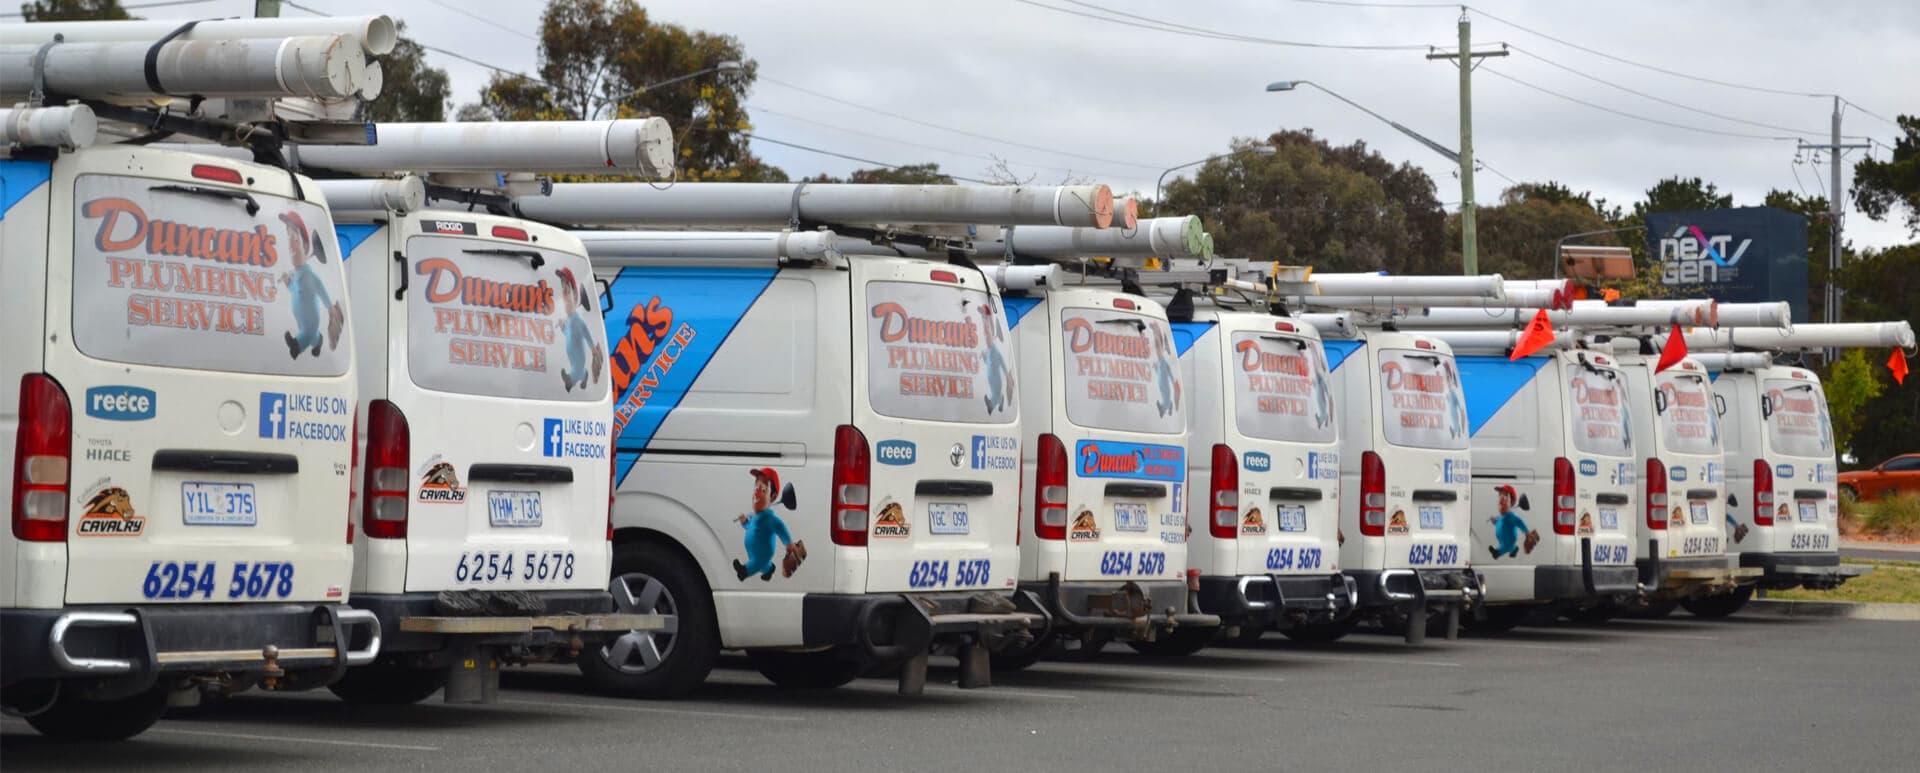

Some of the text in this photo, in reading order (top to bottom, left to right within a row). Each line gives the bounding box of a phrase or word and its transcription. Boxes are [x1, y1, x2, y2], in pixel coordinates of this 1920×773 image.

[82, 197, 278, 268] Duncan's
[105, 256, 278, 303] PLUMBING
[415, 257, 555, 315] Duncan's
[127, 294, 265, 336] SERVICE
[433, 307, 555, 345] PLUMBING
[871, 302, 979, 348] Duncan's
[1064, 317, 1150, 359] Duncan's
[449, 338, 547, 373] SERVICE
[887, 345, 979, 374] PLUMBING
[900, 371, 974, 399] SERVICE
[93, 392, 150, 414] reece
[288, 395, 347, 415] LIKE US ON
[288, 422, 346, 442] FACEBOOK
[564, 419, 606, 437] LIKE US ON
[564, 443, 606, 459] FACEBOOK
[880, 446, 912, 459] reece
[987, 436, 1000, 449] LIKE
[1001, 437, 1008, 449] US
[86, 449, 131, 461] HIACE
[987, 456, 1016, 470] FACEBOOK
[186, 491, 252, 514] YIL 37S
[420, 489, 465, 500] CAVALRY
[80, 520, 142, 532] CAVALRY
[874, 526, 909, 536] CAVALRY
[1791, 534, 1810, 549] 6254
[1101, 551, 1165, 576] 6254 5678
[1266, 548, 1321, 570] 6254 5678
[1409, 544, 1458, 564] 6254 5678
[1594, 544, 1611, 563] 6254
[456, 553, 575, 581] 6254 5678
[909, 559, 991, 588] 6254 5678
[143, 561, 295, 599] 6254 5678
